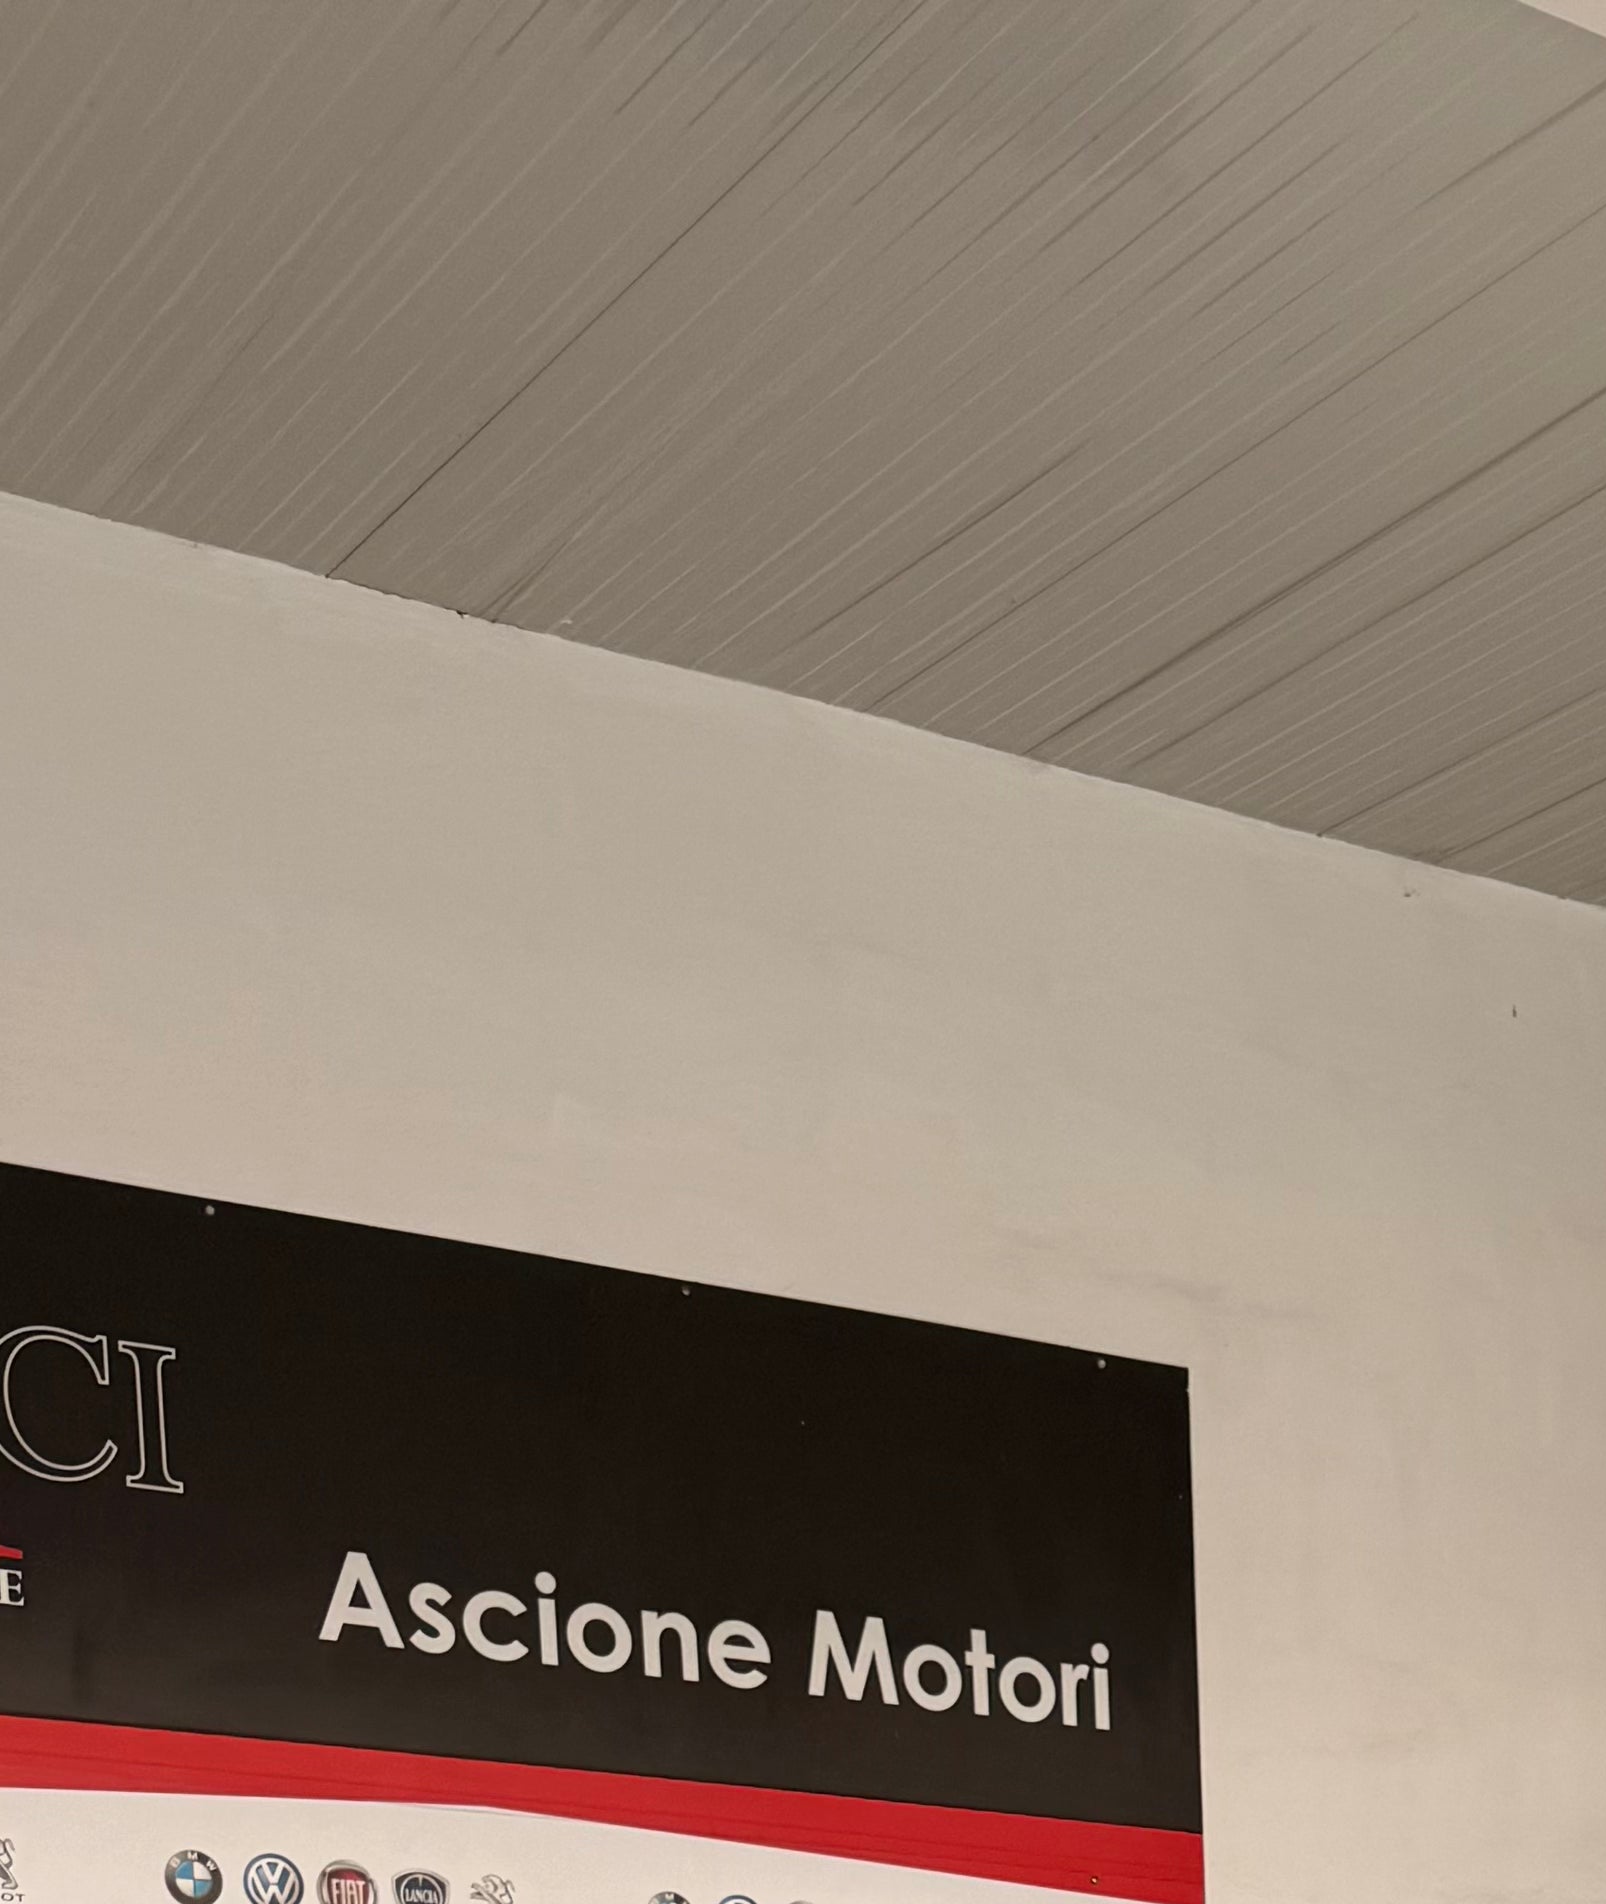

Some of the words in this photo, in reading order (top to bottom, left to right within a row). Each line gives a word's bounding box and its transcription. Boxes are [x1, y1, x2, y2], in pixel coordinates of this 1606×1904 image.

[318, 1552, 772, 1691] Ascione
[807, 1610, 1112, 1730] Motori
[405, 1888, 438, 1904] LANCIA
